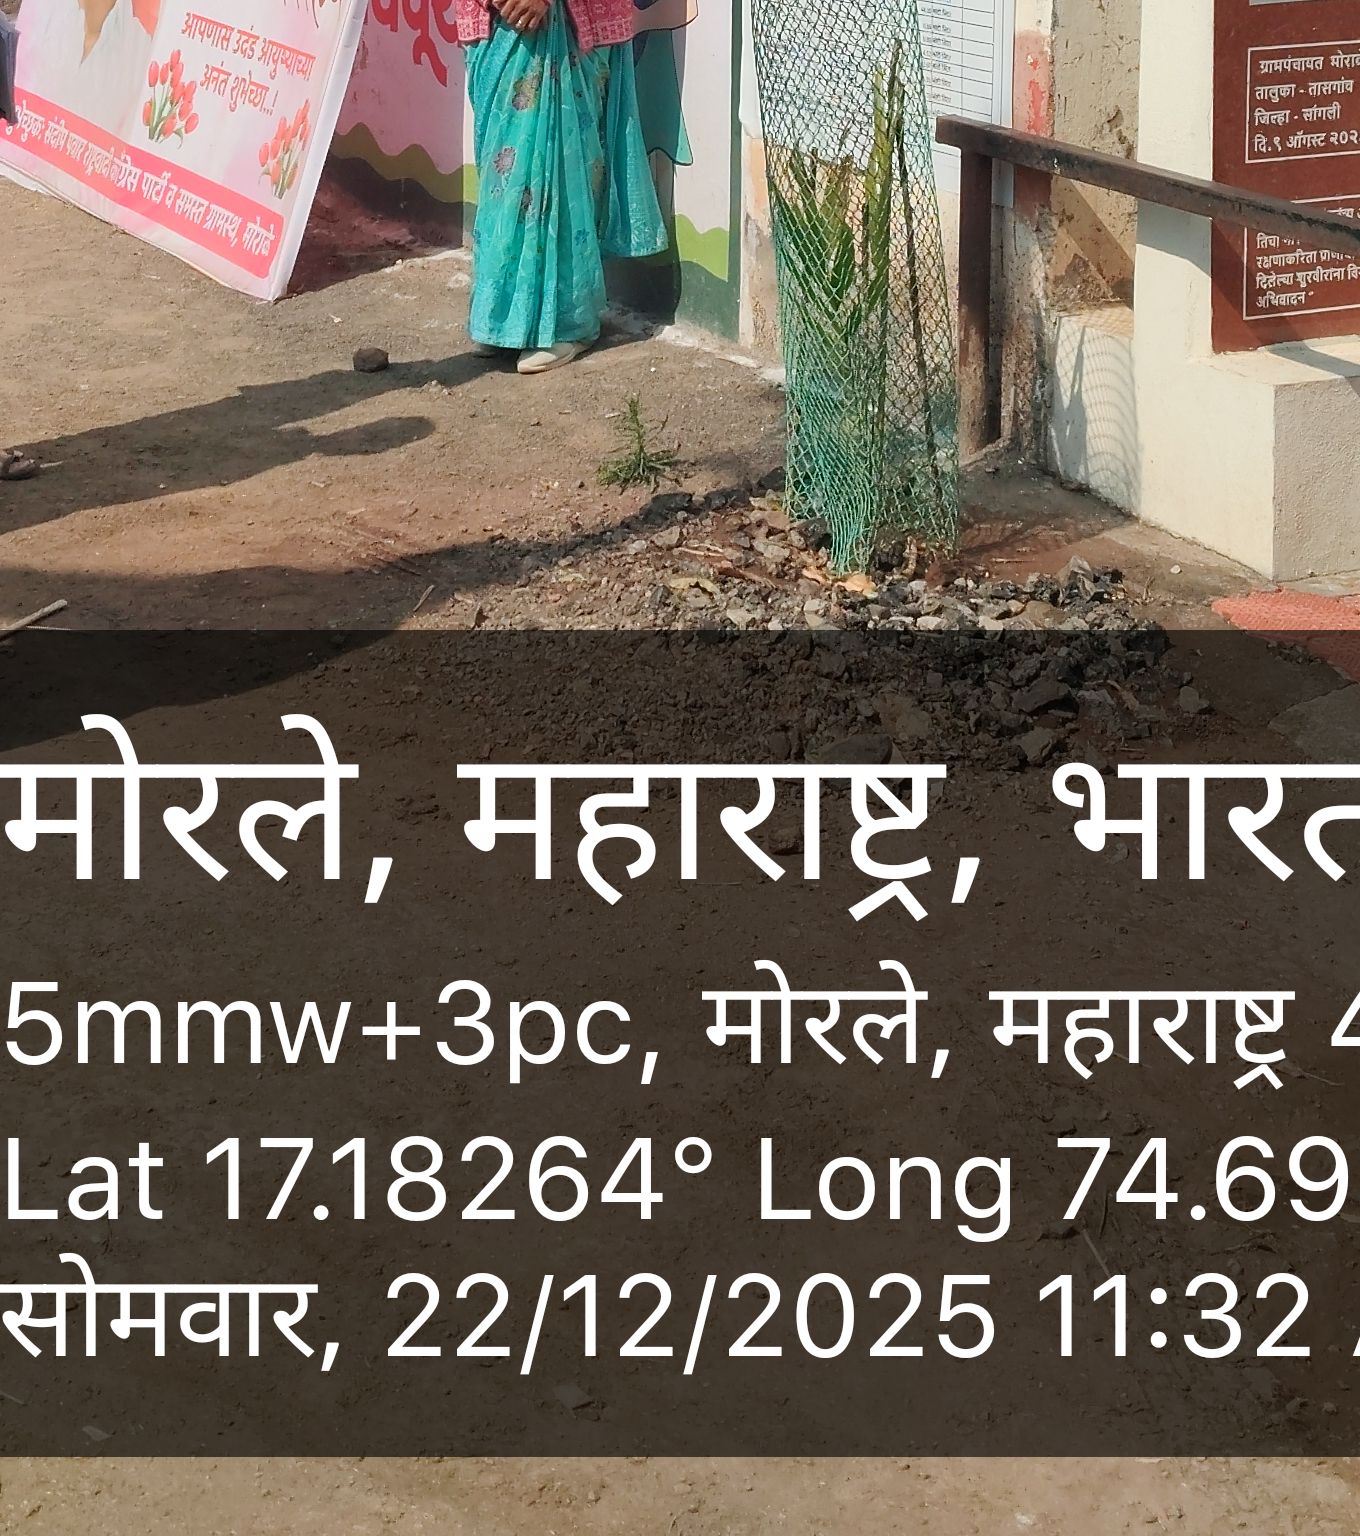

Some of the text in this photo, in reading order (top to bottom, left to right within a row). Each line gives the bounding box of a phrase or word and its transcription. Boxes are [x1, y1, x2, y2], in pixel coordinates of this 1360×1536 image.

[181, 12, 235, 52] आपणास
[232, 25, 260, 60] उदंड
[1259, 55, 1324, 74] ग्रामपंचायत
[200, 60, 232, 97] अनंत
[1255, 76, 1354, 103] तालुका तासगांव
[1254, 102, 1341, 126] जिल्हा सांगली
[1287, 129, 1326, 150] ऑगस्ट
[142, 170, 172, 205] पार्टी
[165, 183, 178, 209] व
[175, 188, 210, 225] समस्त
[1256, 233, 1280, 249] तिचा
[1256, 249, 1317, 270] रक्षणाकरिता
[1256, 270, 1294, 289] दिलेल्या
[1256, 291, 1306, 308] अभिवादन
